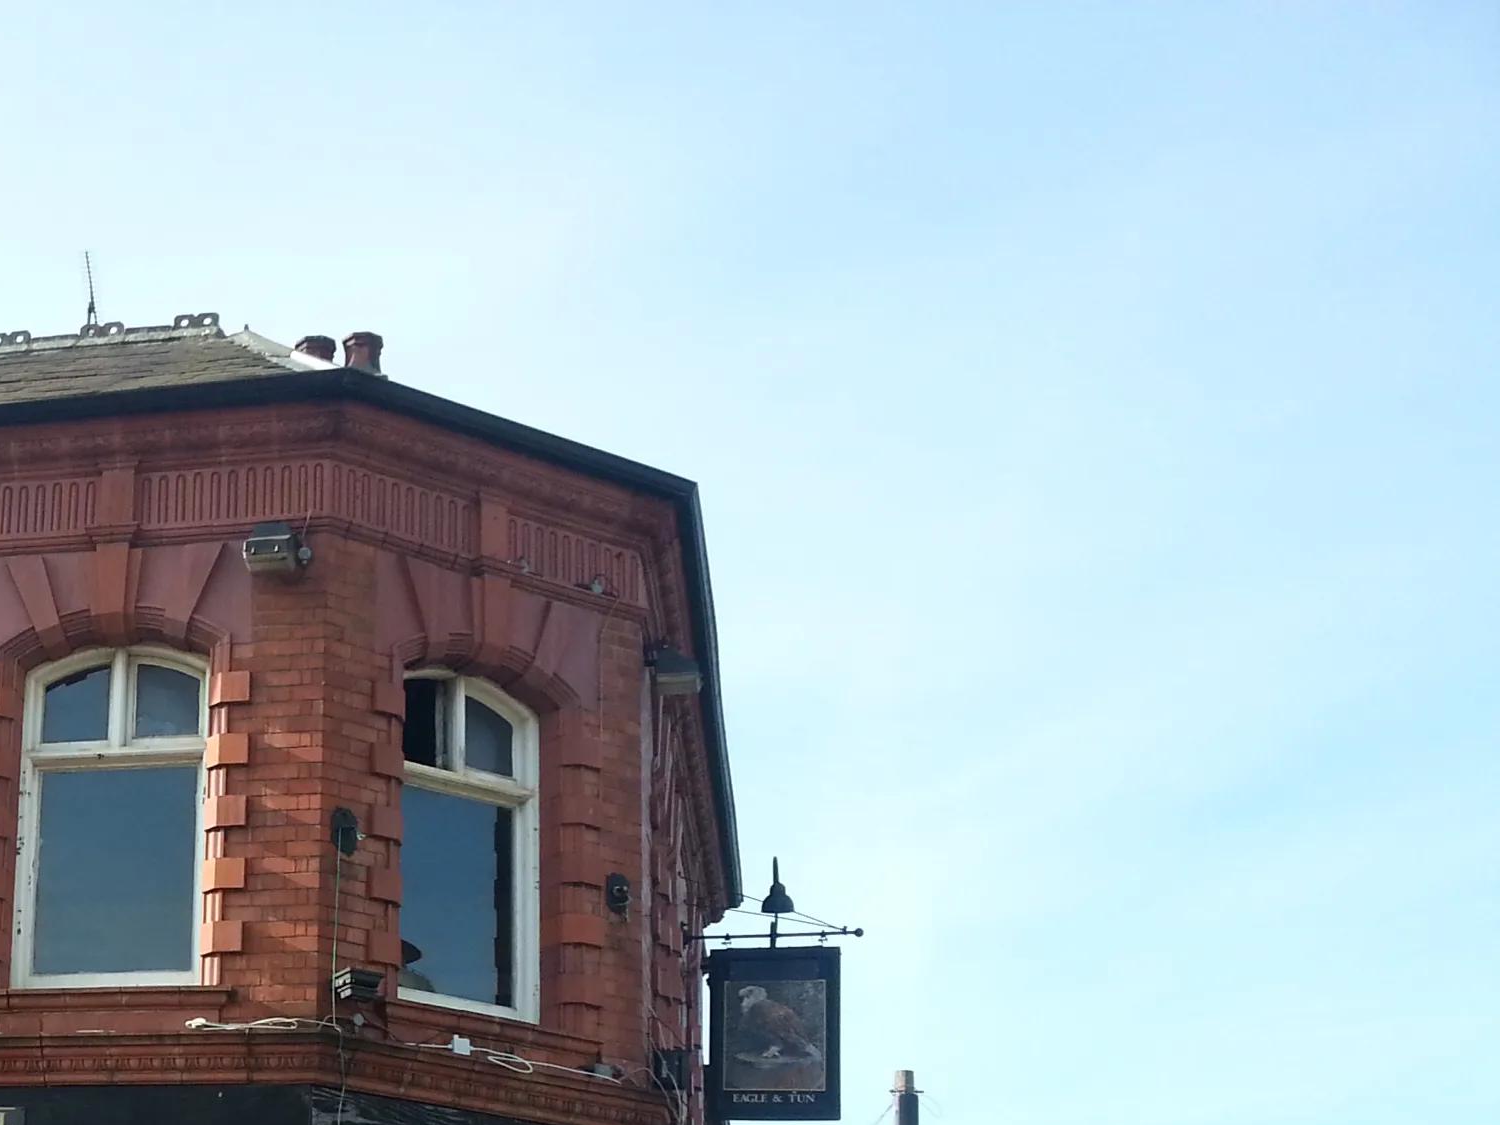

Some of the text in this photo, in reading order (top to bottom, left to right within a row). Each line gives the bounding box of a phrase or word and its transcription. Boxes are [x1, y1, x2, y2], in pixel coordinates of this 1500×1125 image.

[732, 1093, 816, 1103] EAGLE & TUN
